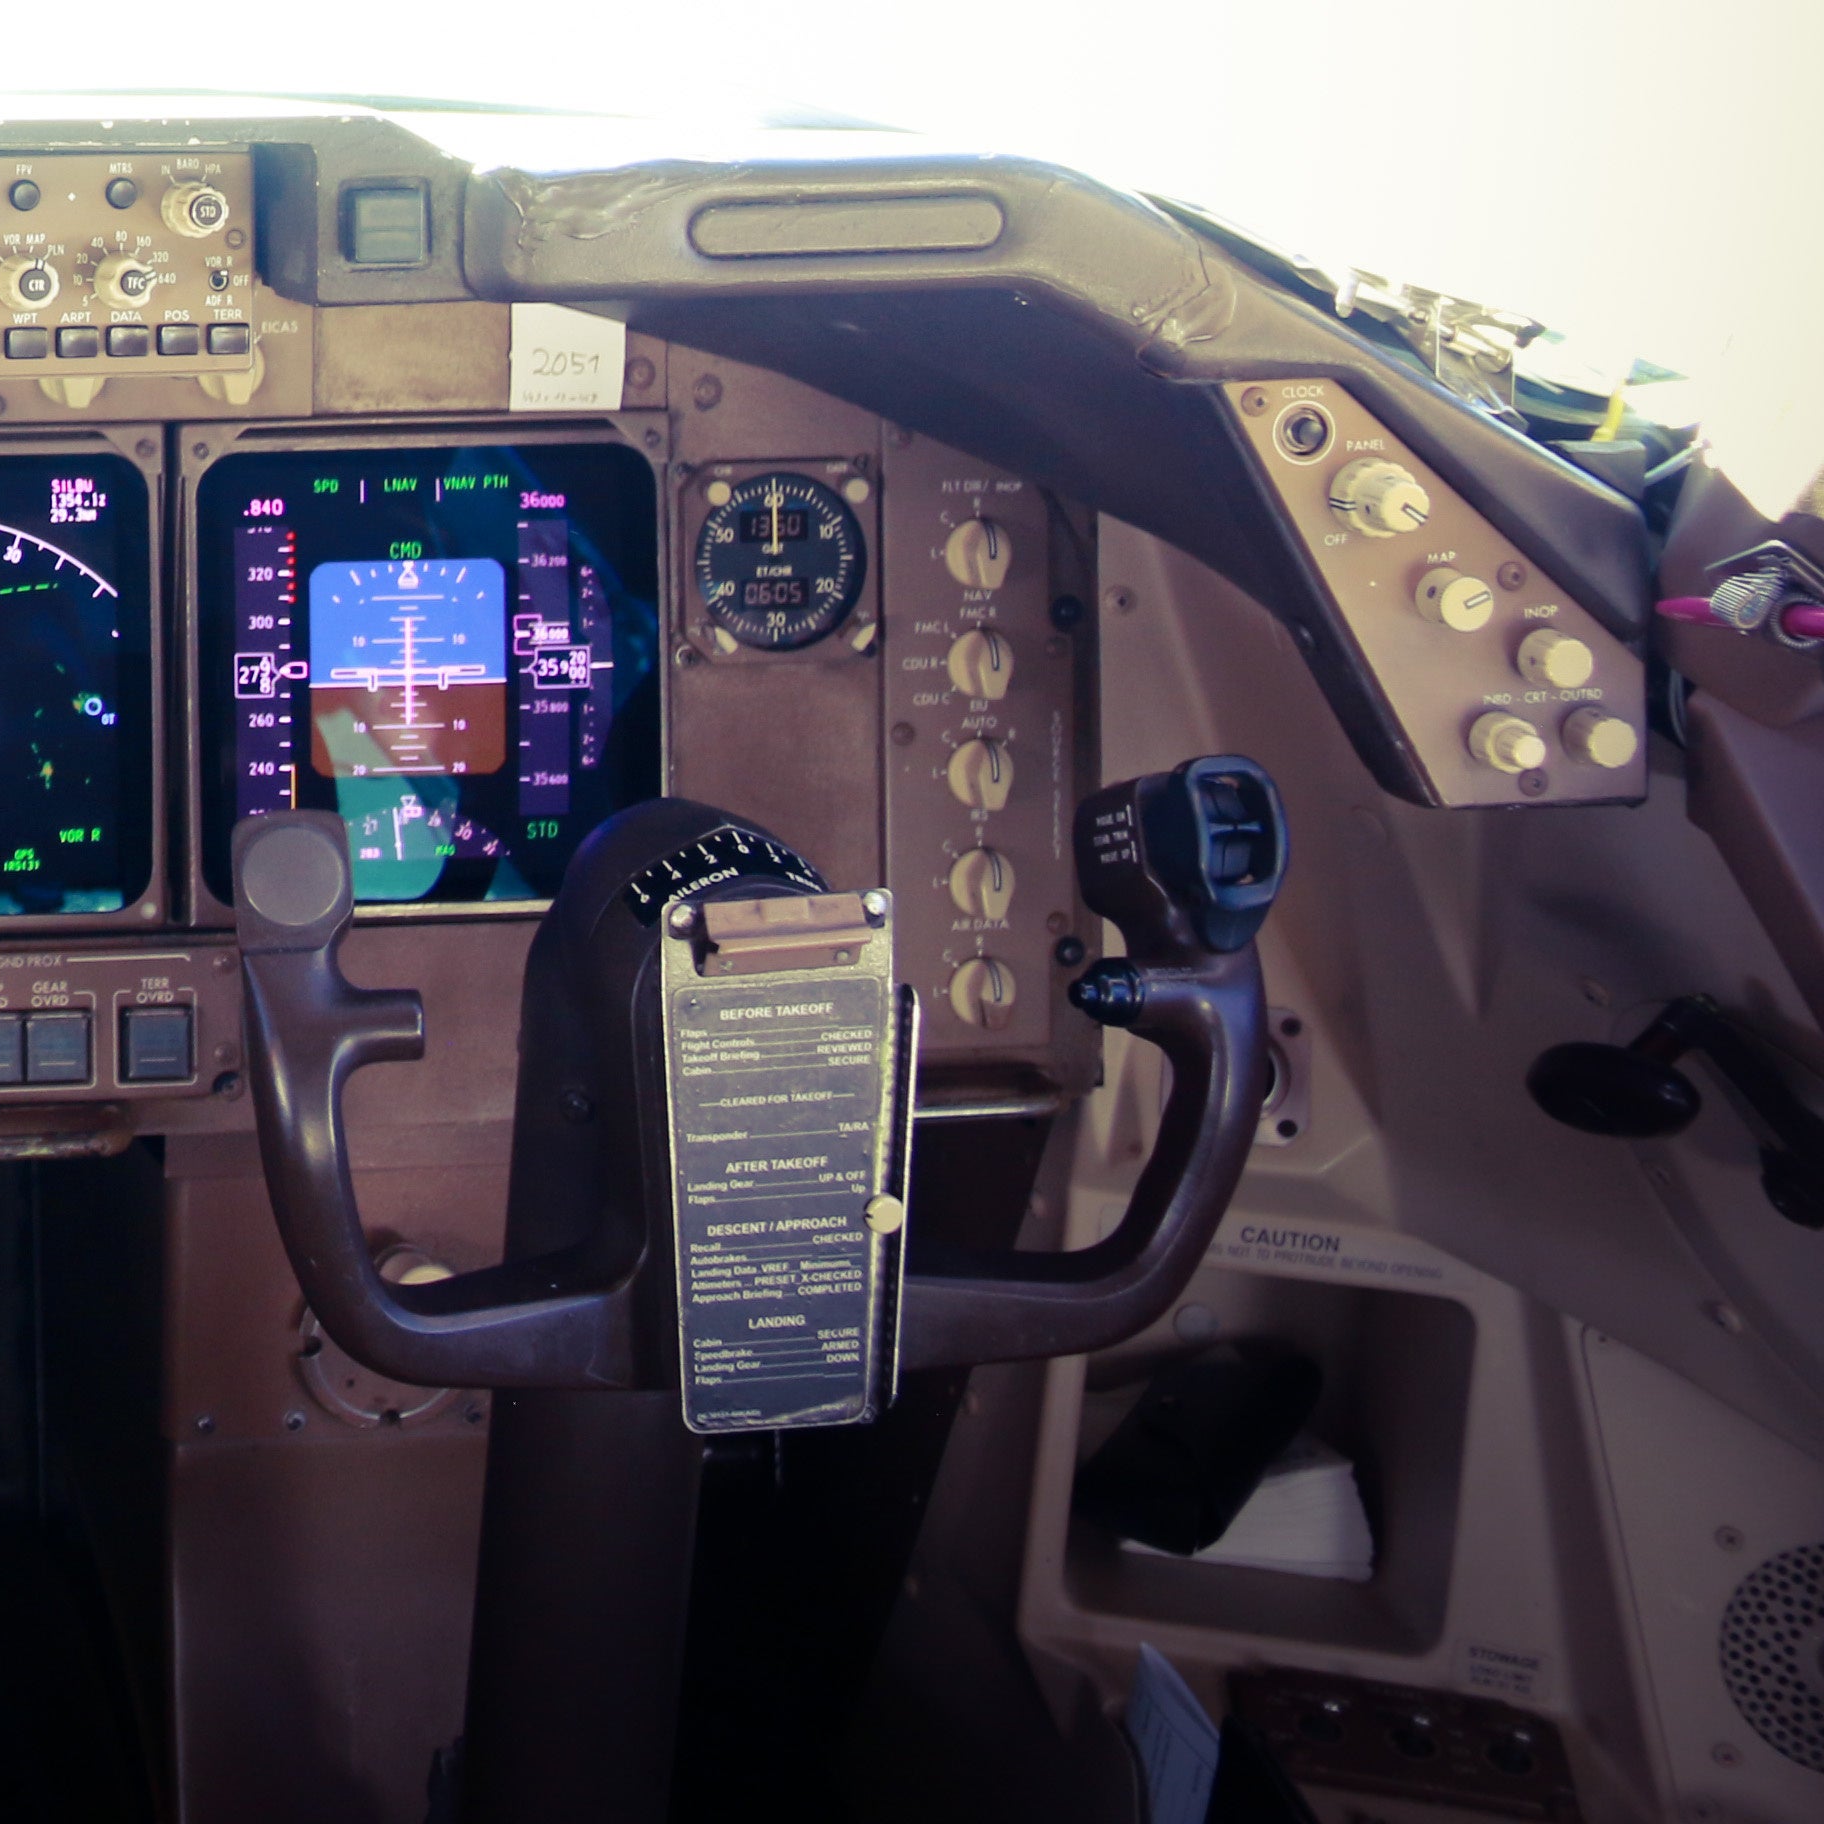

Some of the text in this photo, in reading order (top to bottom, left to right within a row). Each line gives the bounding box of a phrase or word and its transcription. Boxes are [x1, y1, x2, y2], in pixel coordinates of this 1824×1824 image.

[200, 206, 216, 217] STD
[128, 277, 145, 289] TFC
[12, 313, 38, 324] WPT
[60, 311, 92, 323] ARPT
[110, 311, 142, 322] DATA
[164, 310, 190, 321] POS
[213, 309, 243, 320] TERR
[533, 348, 600, 376] 2051
[314, 479, 338, 493] SPD
[384, 478, 416, 491] LNAV
[444, 475, 508, 489] VNAV PTH
[520, 491, 565, 508] 36000
[244, 499, 283, 516] .840
[390, 542, 421, 559] CMD
[249, 615, 274, 629] 300
[528, 822, 558, 839] STD
[720, 1003, 833, 1020] BEFORE TAKEOFF
[820, 1029, 873, 1042] CHECKED
[816, 1042, 872, 1054] REVIEWED
[828, 1055, 871, 1066] SECURE
[719, 1091, 834, 1108] CLEARED FOR TAKEOFF
[726, 1156, 827, 1173] AFTER TAKEOFF
[708, 1217, 846, 1236] DESCENT APPROACH
[813, 1233, 863, 1244] CHECKED
[1240, 1226, 1341, 1253] CAUTION
[749, 1315, 805, 1329] LANDING
[818, 1327, 860, 1339] SECURE
[827, 1353, 859, 1363] DOWN
